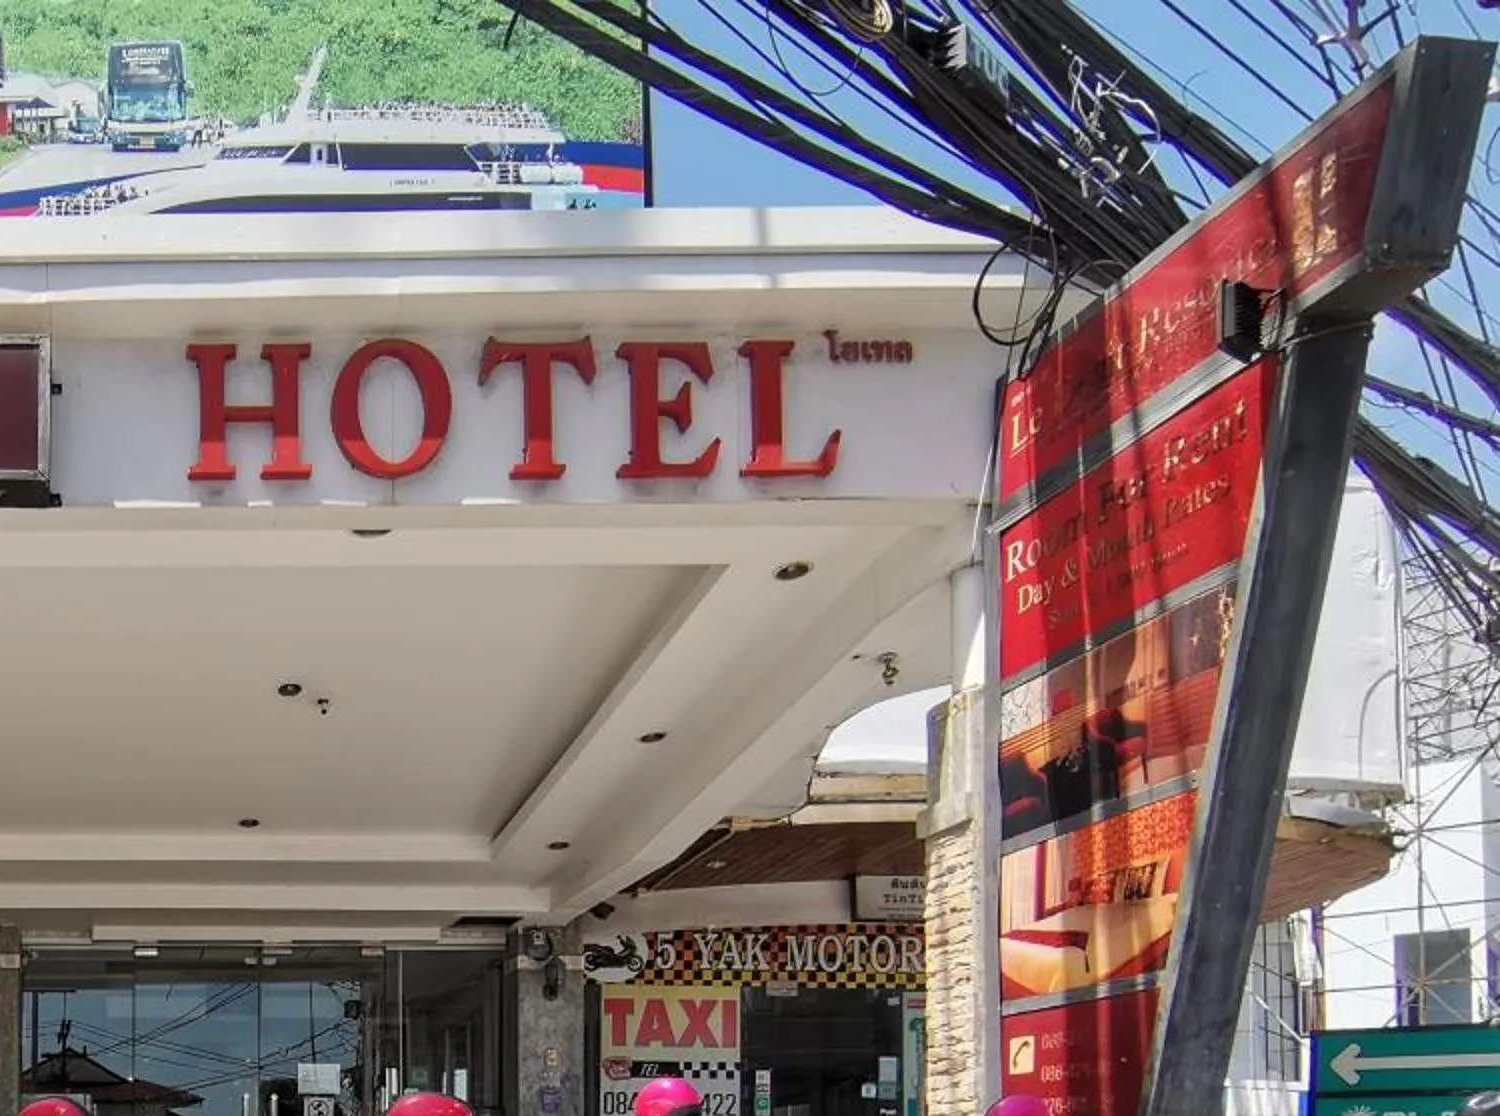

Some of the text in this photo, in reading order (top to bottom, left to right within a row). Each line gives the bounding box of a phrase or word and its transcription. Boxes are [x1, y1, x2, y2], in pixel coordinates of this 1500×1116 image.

[186, 337, 841, 480] HOTEL
[1161, 399, 1249, 484] Rent
[1017, 575, 1056, 616] Day
[655, 932, 925, 974] 5 YAK MOTOR
[603, 998, 740, 1049] TAXI
